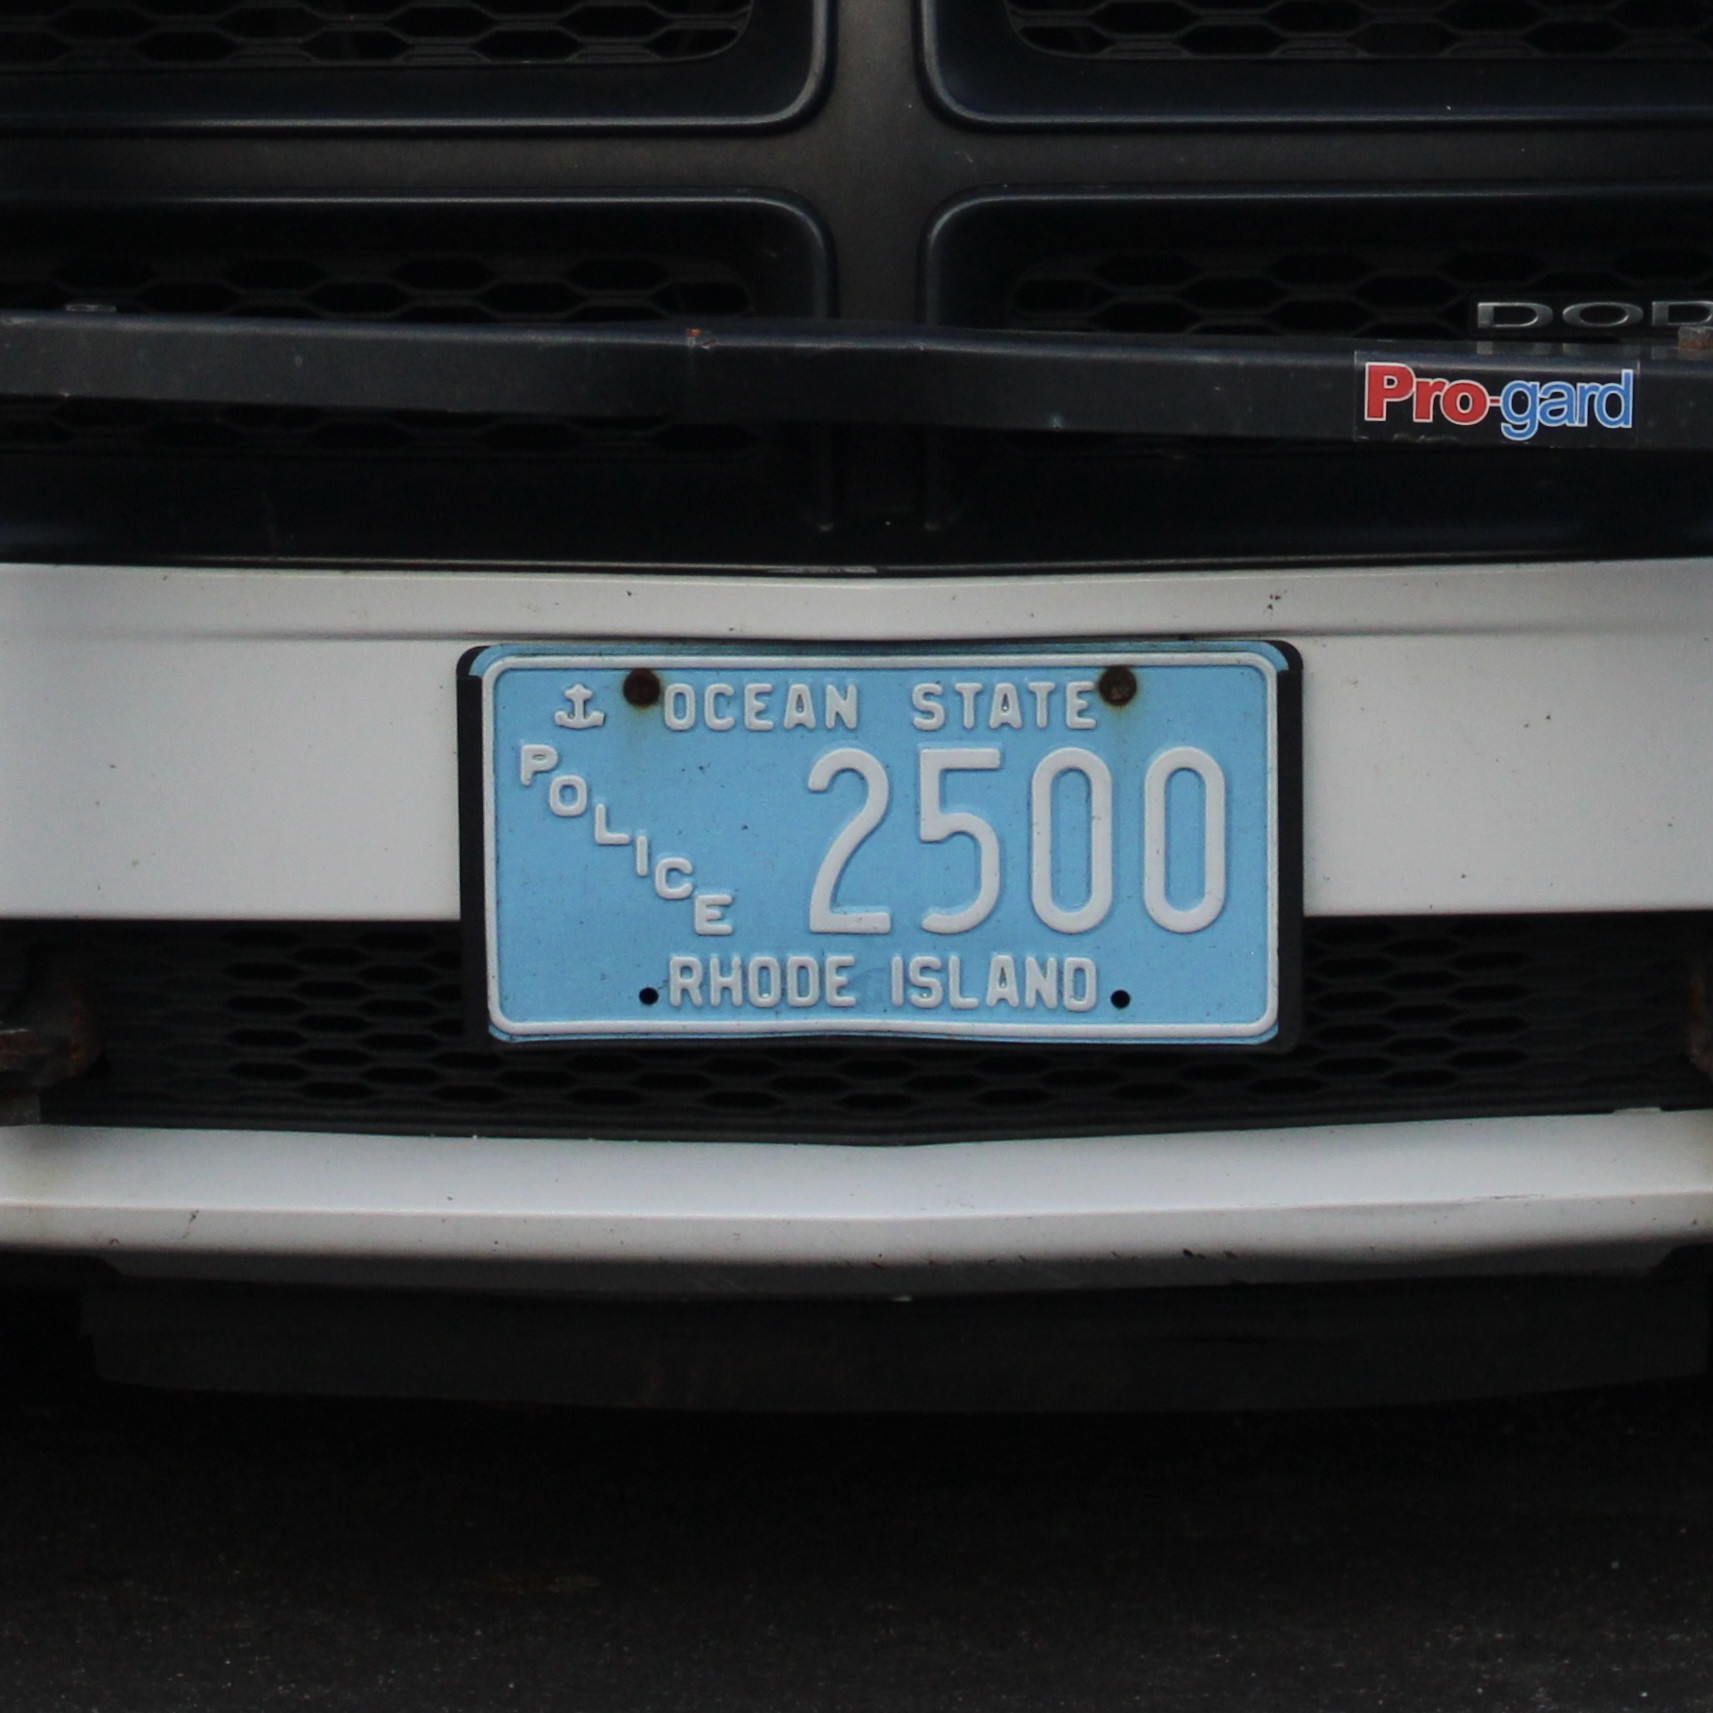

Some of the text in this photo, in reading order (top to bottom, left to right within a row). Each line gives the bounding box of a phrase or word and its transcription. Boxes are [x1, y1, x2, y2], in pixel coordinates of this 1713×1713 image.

[1364, 362, 1634, 441] Pro-gard
[662, 682, 1099, 732] OCEAN STATE
[519, 744, 733, 937] POLICE
[807, 746, 1226, 935] 2500
[668, 955, 1098, 1011] RHODE ISLAND
